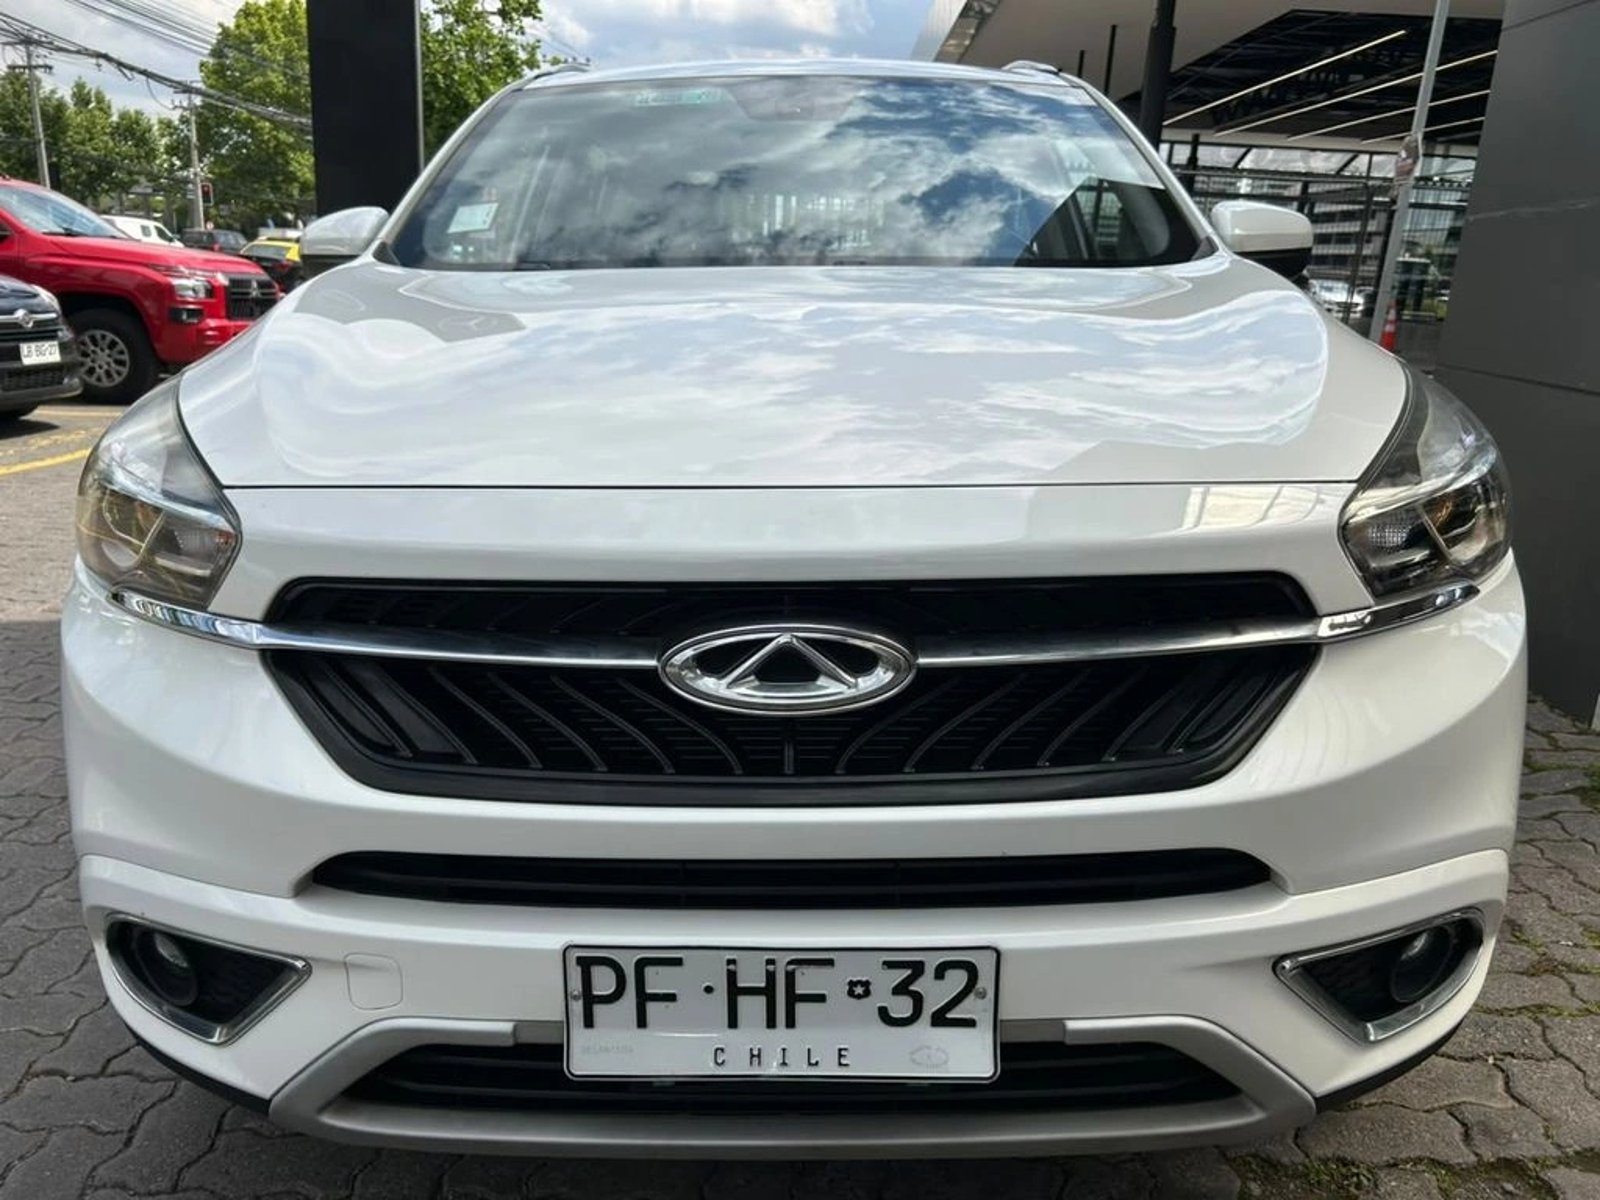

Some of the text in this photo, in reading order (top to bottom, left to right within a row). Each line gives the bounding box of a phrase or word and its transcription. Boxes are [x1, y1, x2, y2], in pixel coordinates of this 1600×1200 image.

[576, 956, 684, 1029] PF
[877, 960, 979, 1028] 32
[713, 1046, 851, 1067] CHILE
